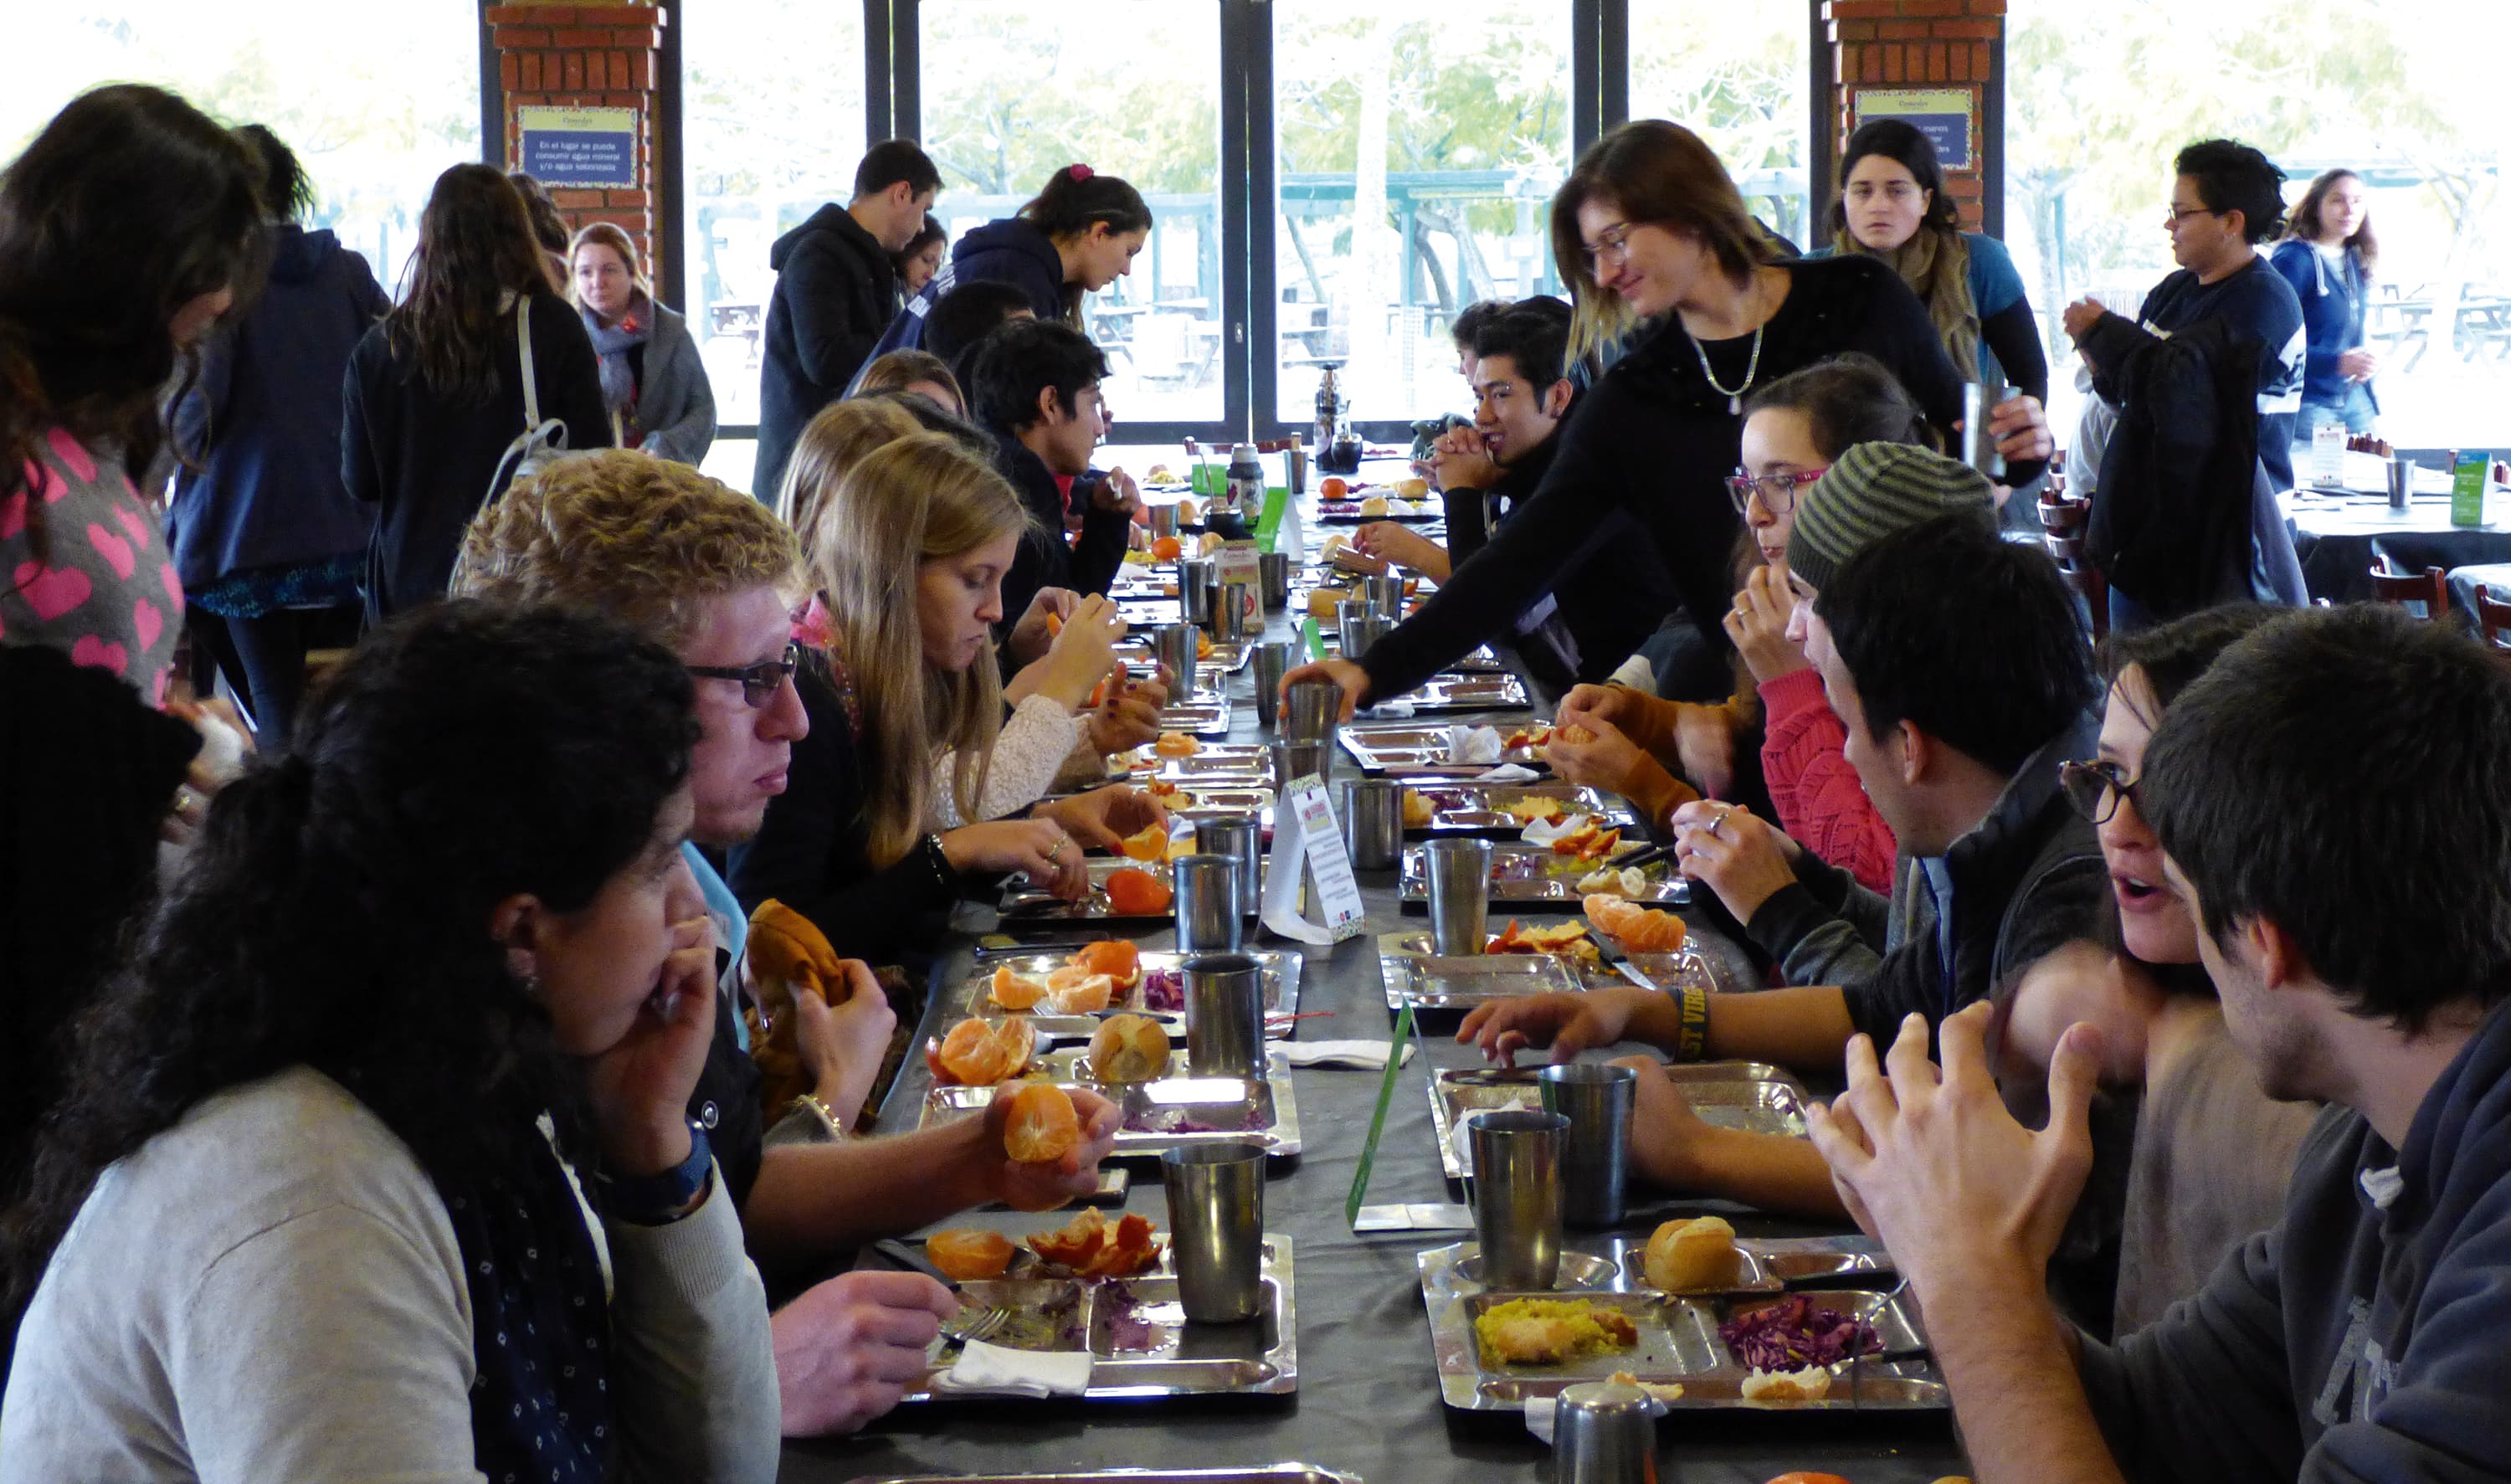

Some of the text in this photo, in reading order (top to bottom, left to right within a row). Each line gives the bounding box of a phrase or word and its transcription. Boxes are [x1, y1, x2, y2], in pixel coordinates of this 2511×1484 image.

[540, 141, 549, 149] En
[551, 141, 559, 149] el
[561, 141, 579, 151] lugar
[592, 142, 616, 151] puede
[572, 153, 590, 162] agua
[592, 152, 620, 161] mineral
[539, 162, 617, 172] y/o agua saborizada
